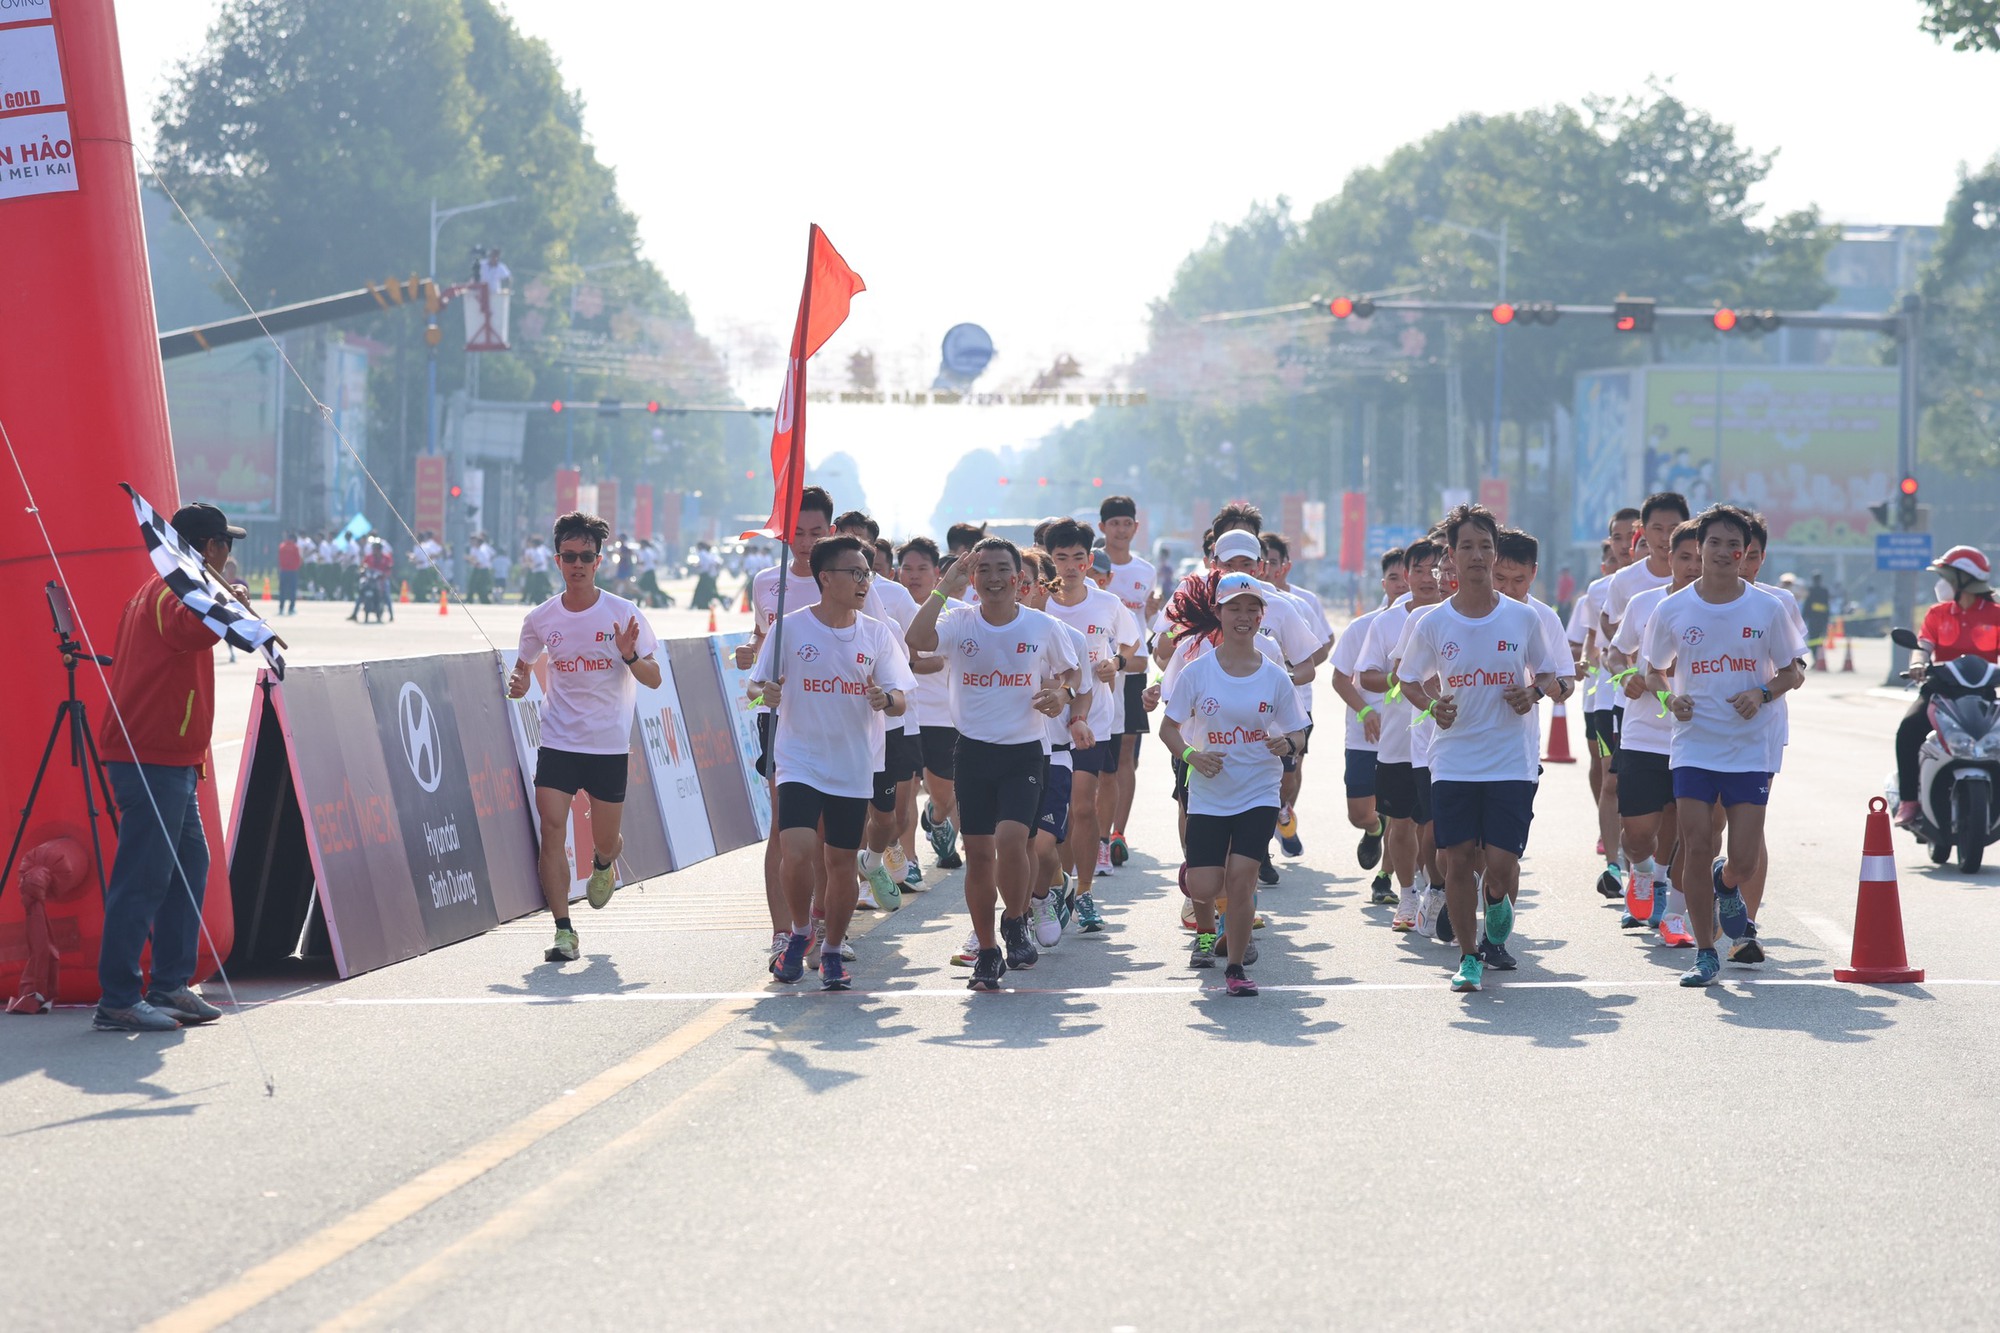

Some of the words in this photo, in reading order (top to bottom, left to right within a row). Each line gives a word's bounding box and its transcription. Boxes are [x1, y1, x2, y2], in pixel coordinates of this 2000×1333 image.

[4, 89, 41, 109] GOLD
[20, 134, 72, 163] HẢO
[9, 165, 39, 180] MEI
[46, 162, 71, 175] KAI
[1087, 624, 1106, 635] BTV
[1742, 626, 1764, 639] BTV
[595, 631, 615, 642] BTV
[1016, 642, 1039, 654] BTV
[1497, 640, 1519, 652] BTV
[856, 652, 874, 666] BTV
[1258, 701, 1275, 713] BTV
[422, 812, 461, 863] Hyundai
